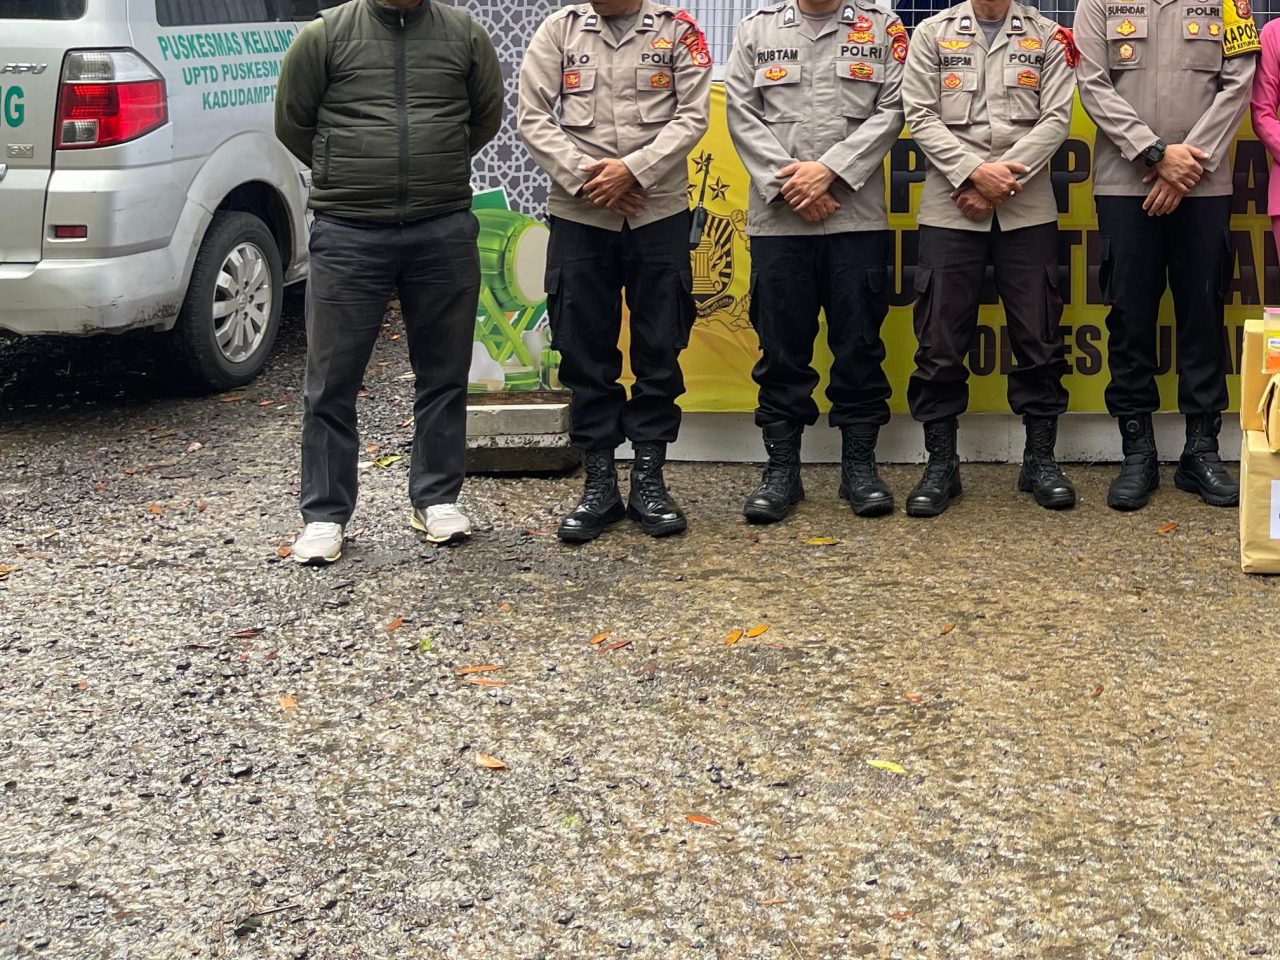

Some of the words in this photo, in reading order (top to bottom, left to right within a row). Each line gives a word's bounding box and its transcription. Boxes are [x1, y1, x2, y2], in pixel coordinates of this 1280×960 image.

[1107, 6, 1146, 16] SUHENDAR
[1187, 7, 1220, 16] POLRI
[157, 31, 243, 61] PUSKESMAS
[241, 29, 295, 55] KELILING
[757, 49, 799, 63] RUSTAM
[841, 46, 882, 59] POLRI
[0, 63, 48, 75] APV
[182, 65, 219, 86] UPTD
[221, 60, 283, 82] PUSKESM
